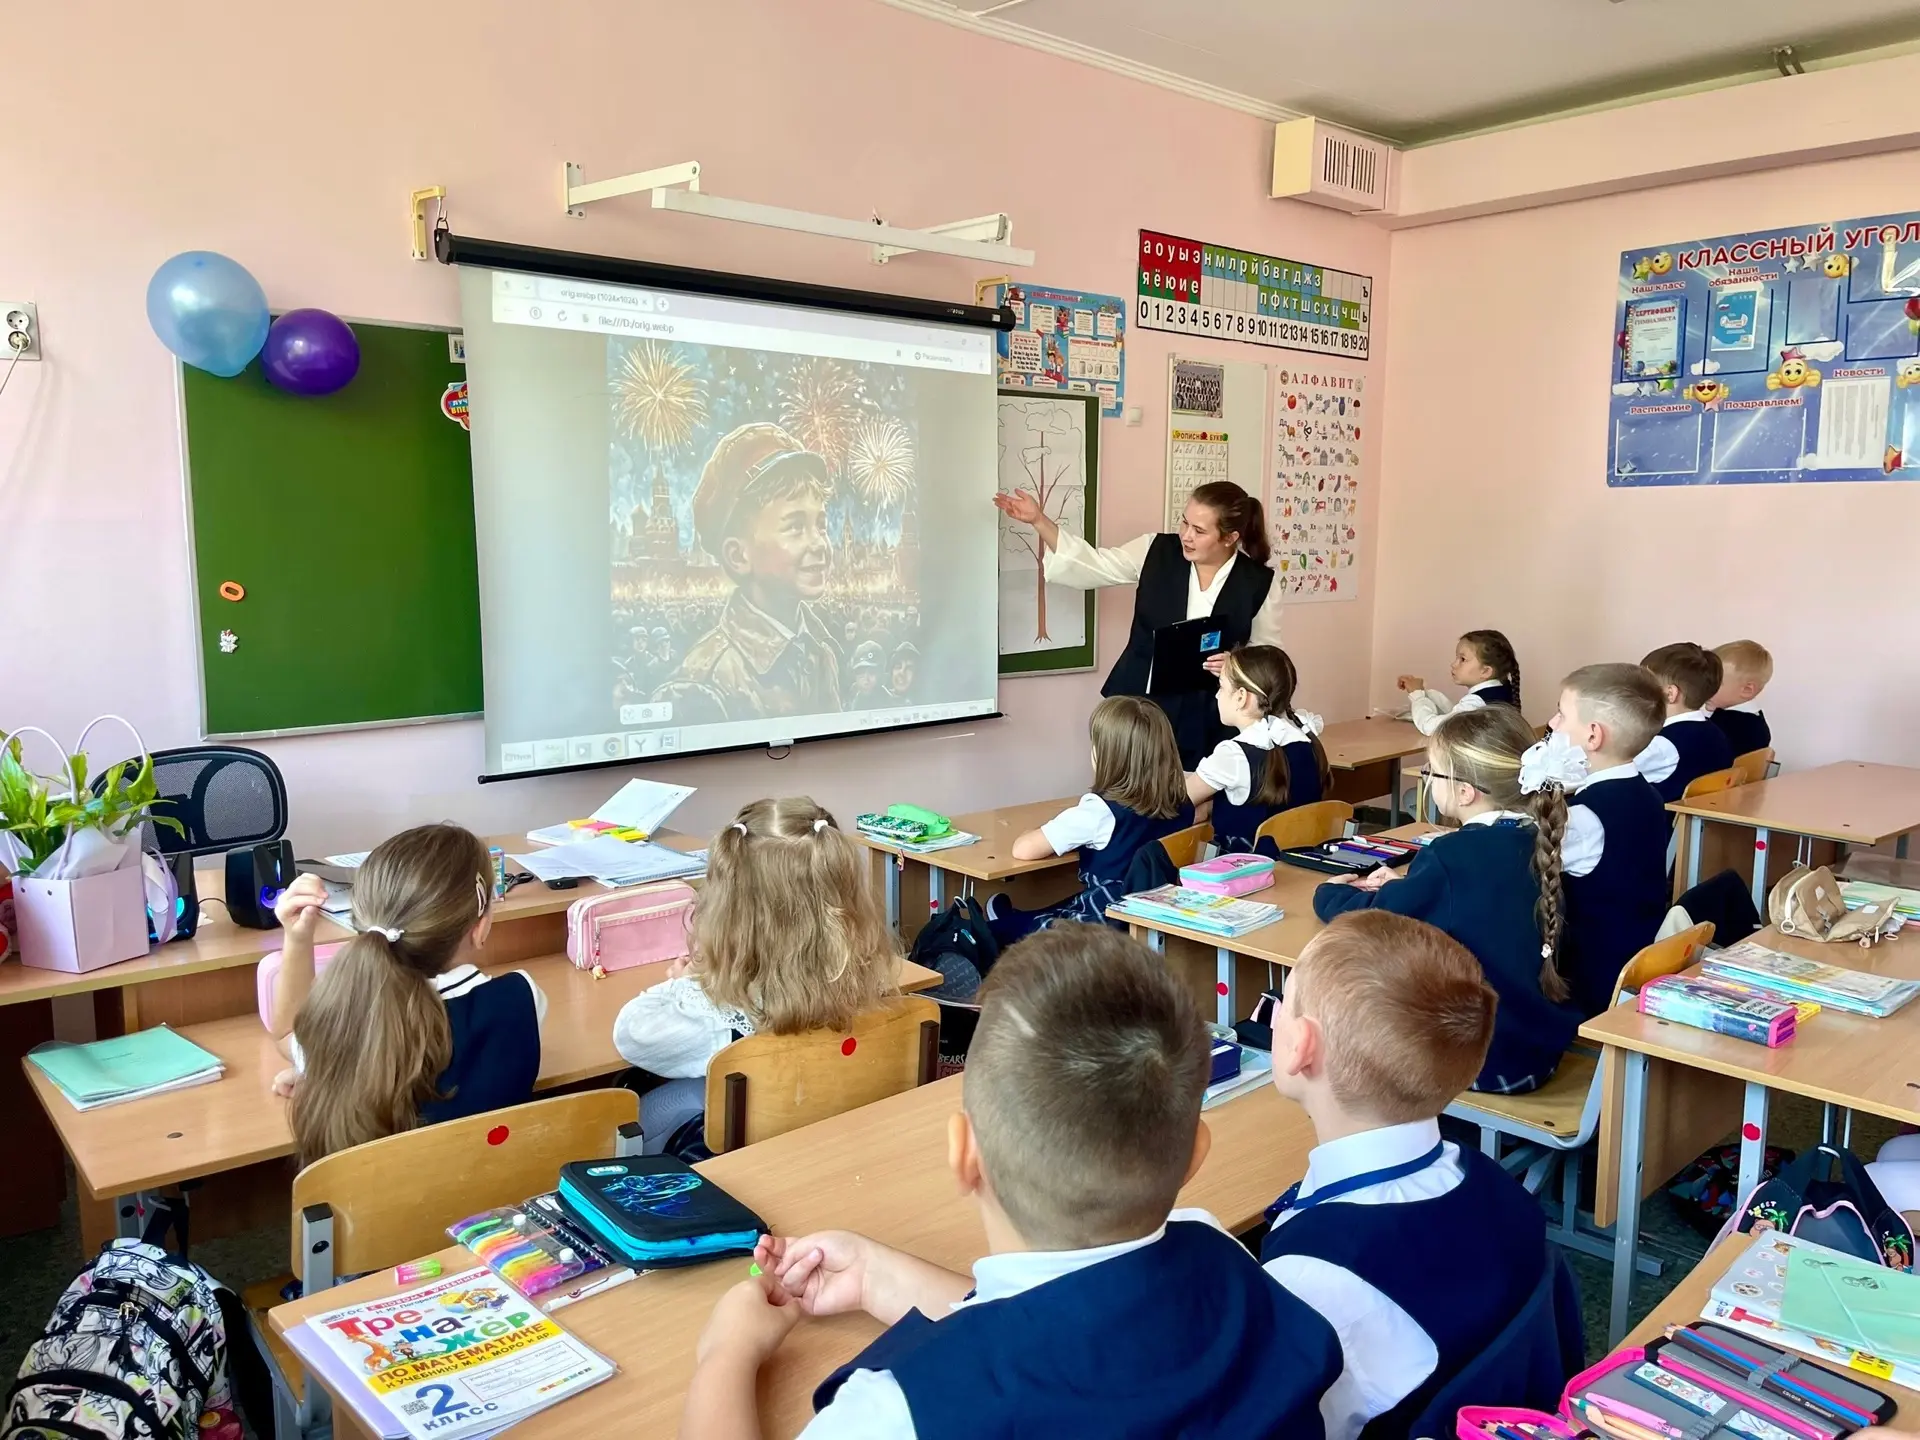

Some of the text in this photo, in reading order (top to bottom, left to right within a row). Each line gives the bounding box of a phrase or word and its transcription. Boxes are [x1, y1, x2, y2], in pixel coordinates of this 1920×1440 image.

[1678, 227, 1835, 270] КЛАССНЫЙ
[1709, 272, 1778, 287] обязанности
[1729, 267, 1759, 276] Наши
[1632, 281, 1685, 294] Наш класс
[598, 315, 674, 334] file:///D:/orig.webp
[1140, 301, 1368, 351] 0 1 2 3 4 5 6 7 8 9 10 11 12 13 14 15 16 17 18 19 20
[1291, 373, 1353, 389] АЛФАВИТ
[1834, 368, 1884, 378] Новости
[1631, 404, 1691, 415] Расписание
[1725, 397, 1803, 410] Поздравляем!
[382, 1292, 426, 1308] НОВОМУ
[432, 1272, 481, 1293] УЧЕБНИКУ
[399, 1315, 472, 1342] на-
[377, 1366, 408, 1383] ПО
[411, 1322, 547, 1373] МАТЕМАТИКЕ
[396, 1362, 459, 1385] УЧЕБНИКУ
[461, 1358, 476, 1367] М.
[477, 1354, 490, 1362] И.
[491, 1341, 525, 1357] МОРО
[416, 1383, 470, 1417] 2
[423, 1402, 499, 1431] КЛАСС
